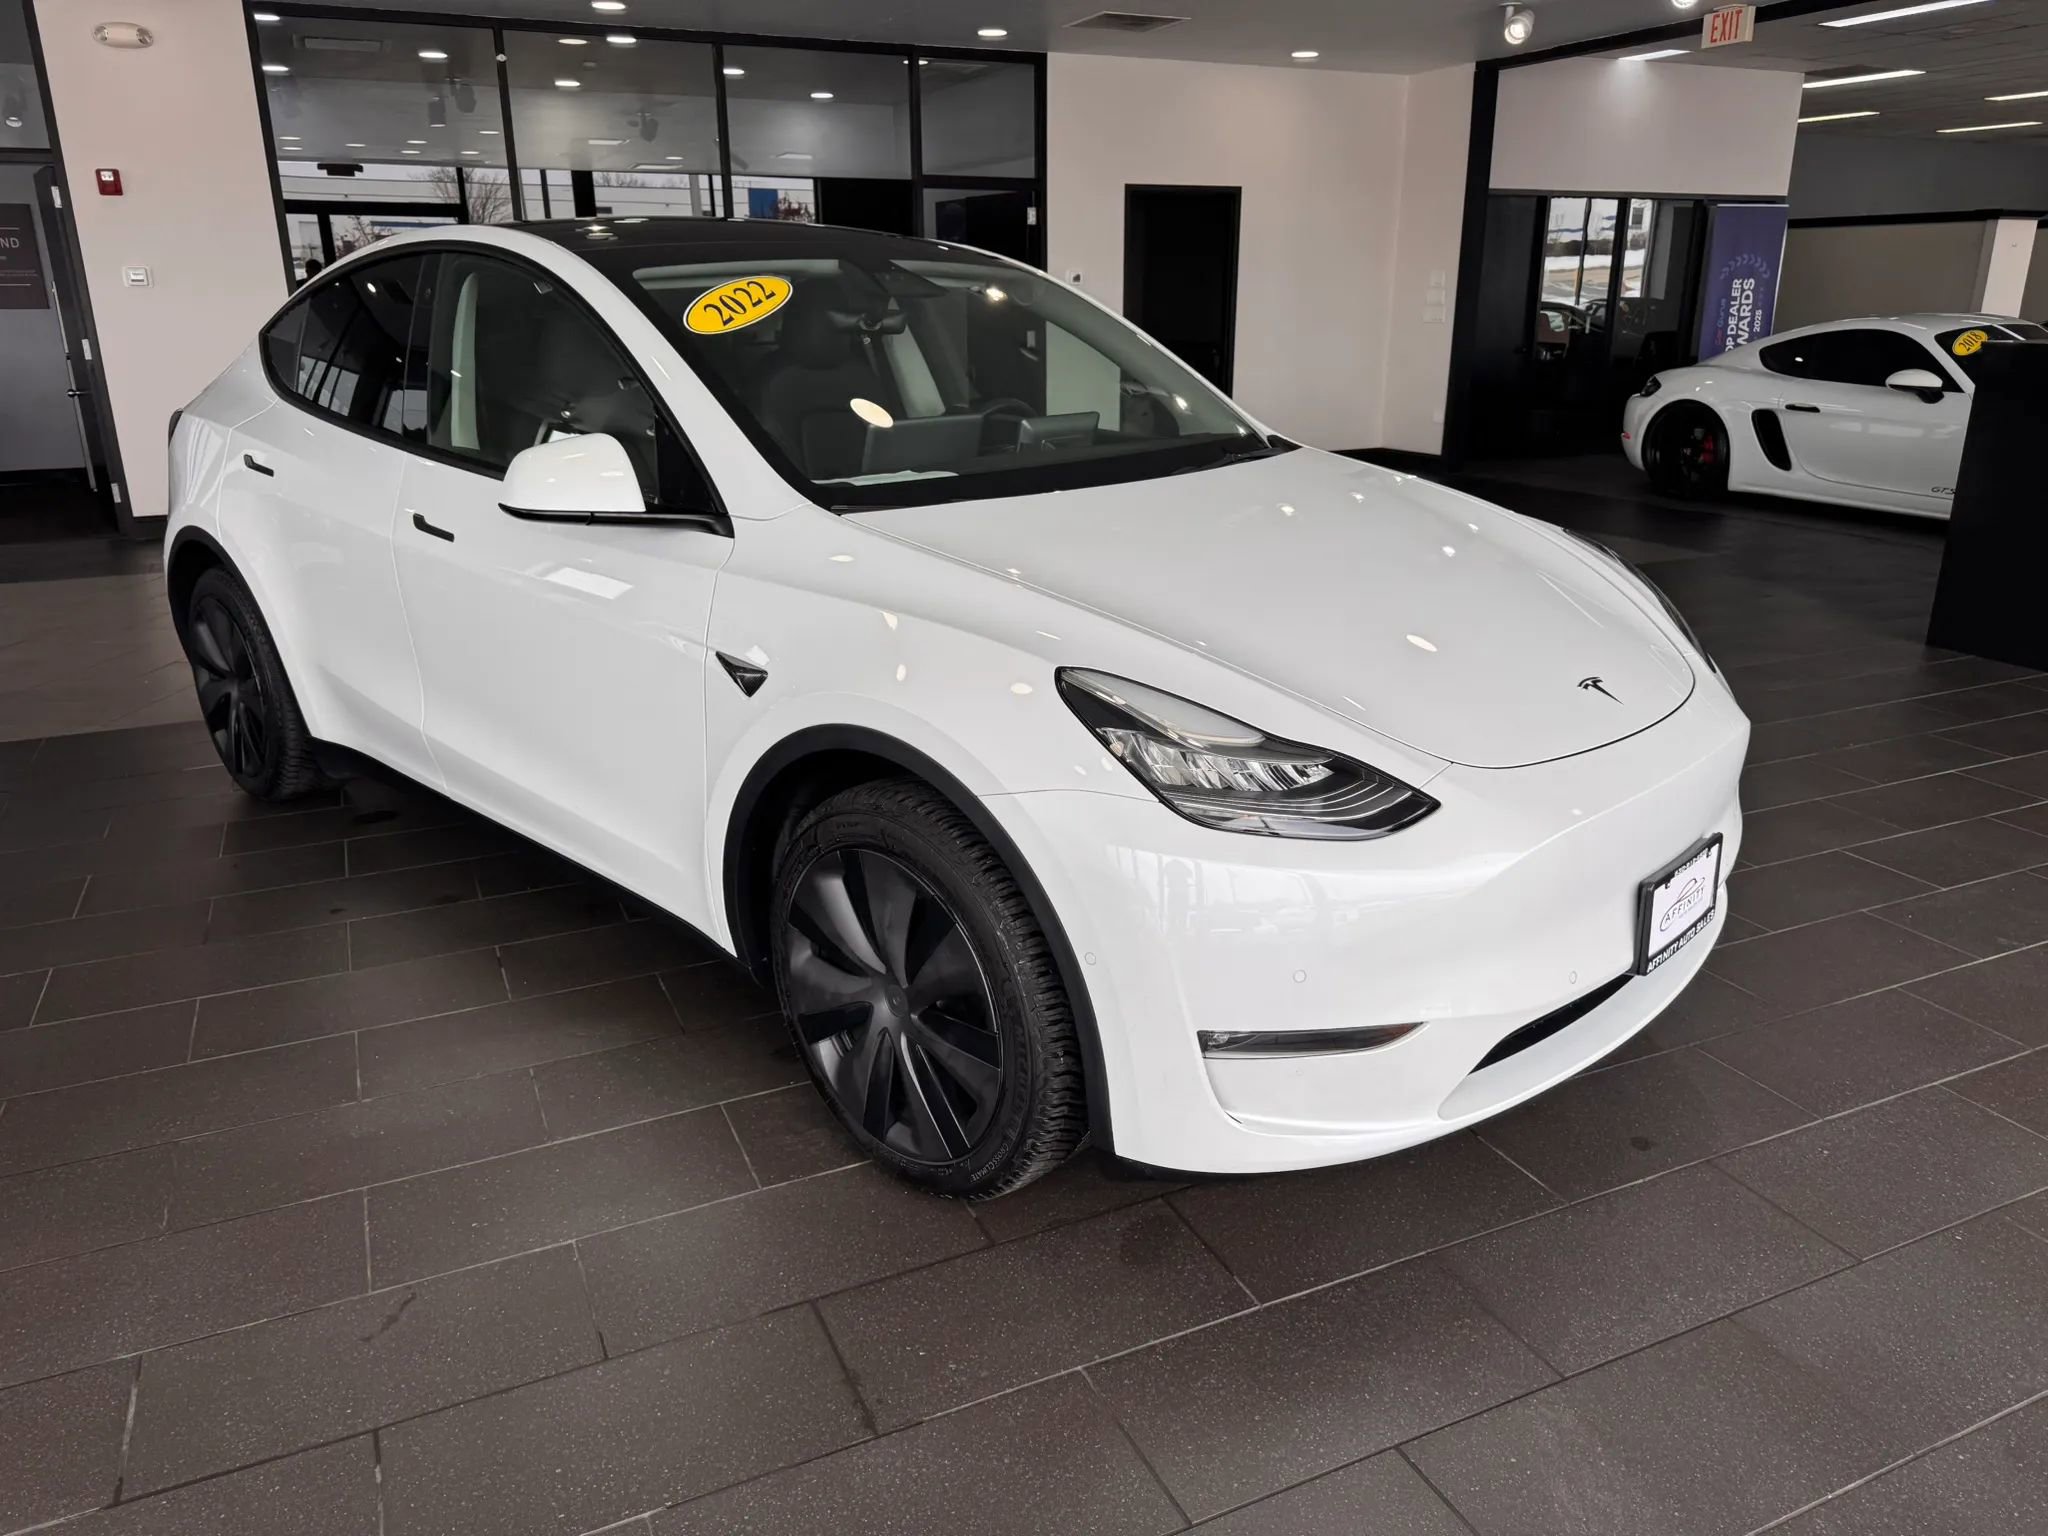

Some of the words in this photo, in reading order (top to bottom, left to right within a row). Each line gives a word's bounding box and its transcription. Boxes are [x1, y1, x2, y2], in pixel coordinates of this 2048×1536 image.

[1710, 8, 1743, 43] EXIT
[703, 280, 777, 327] 2022
[1727, 278, 1743, 335] DEALER
[1736, 277, 1755, 346] WARDS
[1958, 331, 1982, 352] 2018
[1665, 887, 1704, 924] AFFINITY
[1647, 940, 1679, 974] AFFINITY
[1695, 909, 1716, 933] SALES
[970, 1142, 1009, 1182] CROSSCLIMATE
